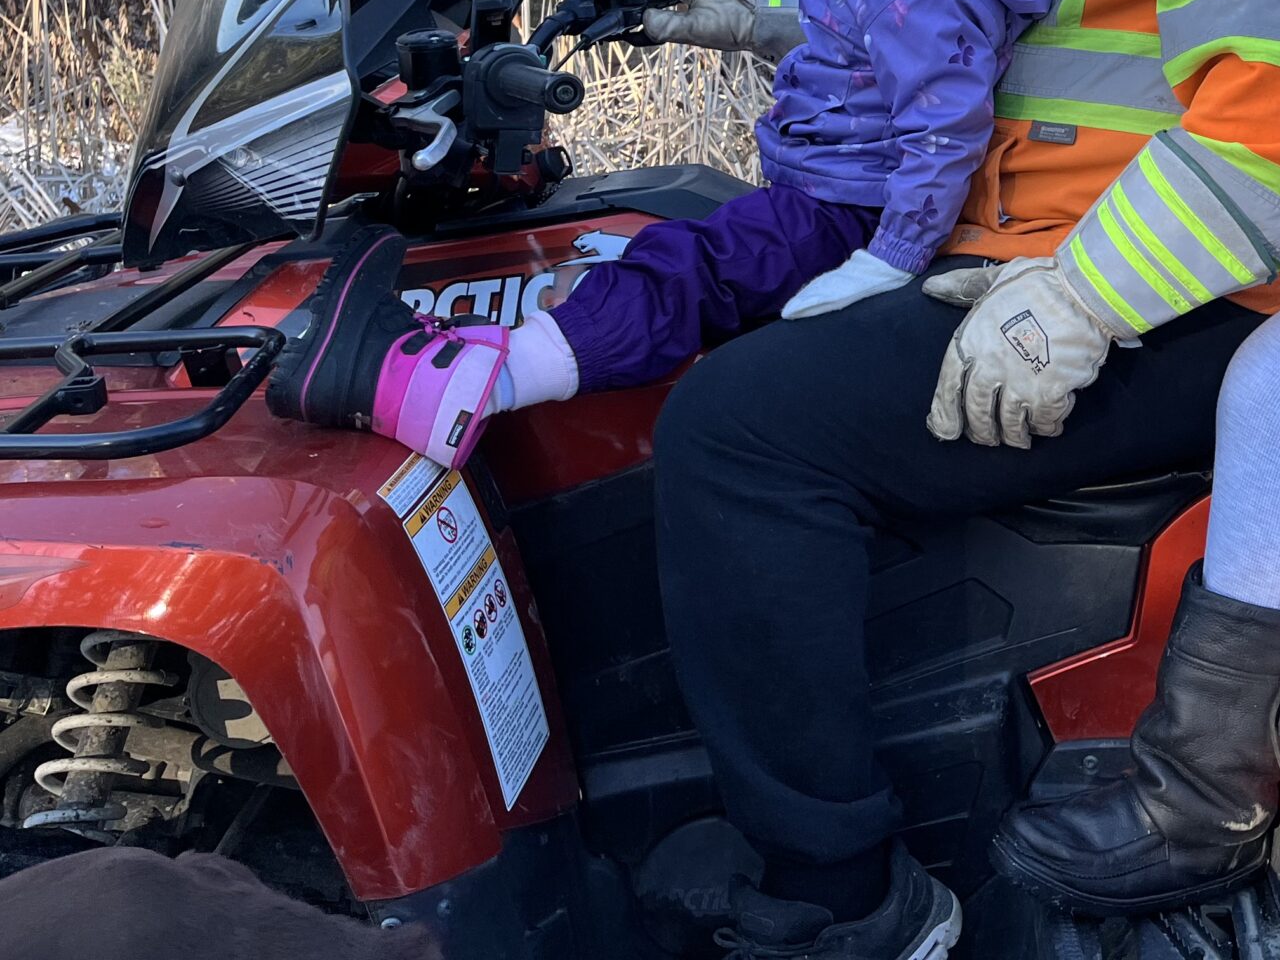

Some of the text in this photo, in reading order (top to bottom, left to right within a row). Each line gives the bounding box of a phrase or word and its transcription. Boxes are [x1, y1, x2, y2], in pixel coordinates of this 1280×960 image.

[401, 272, 555, 327] RCTIC
[423, 480, 453, 515] WARNING
[461, 558, 488, 597] WARNING
